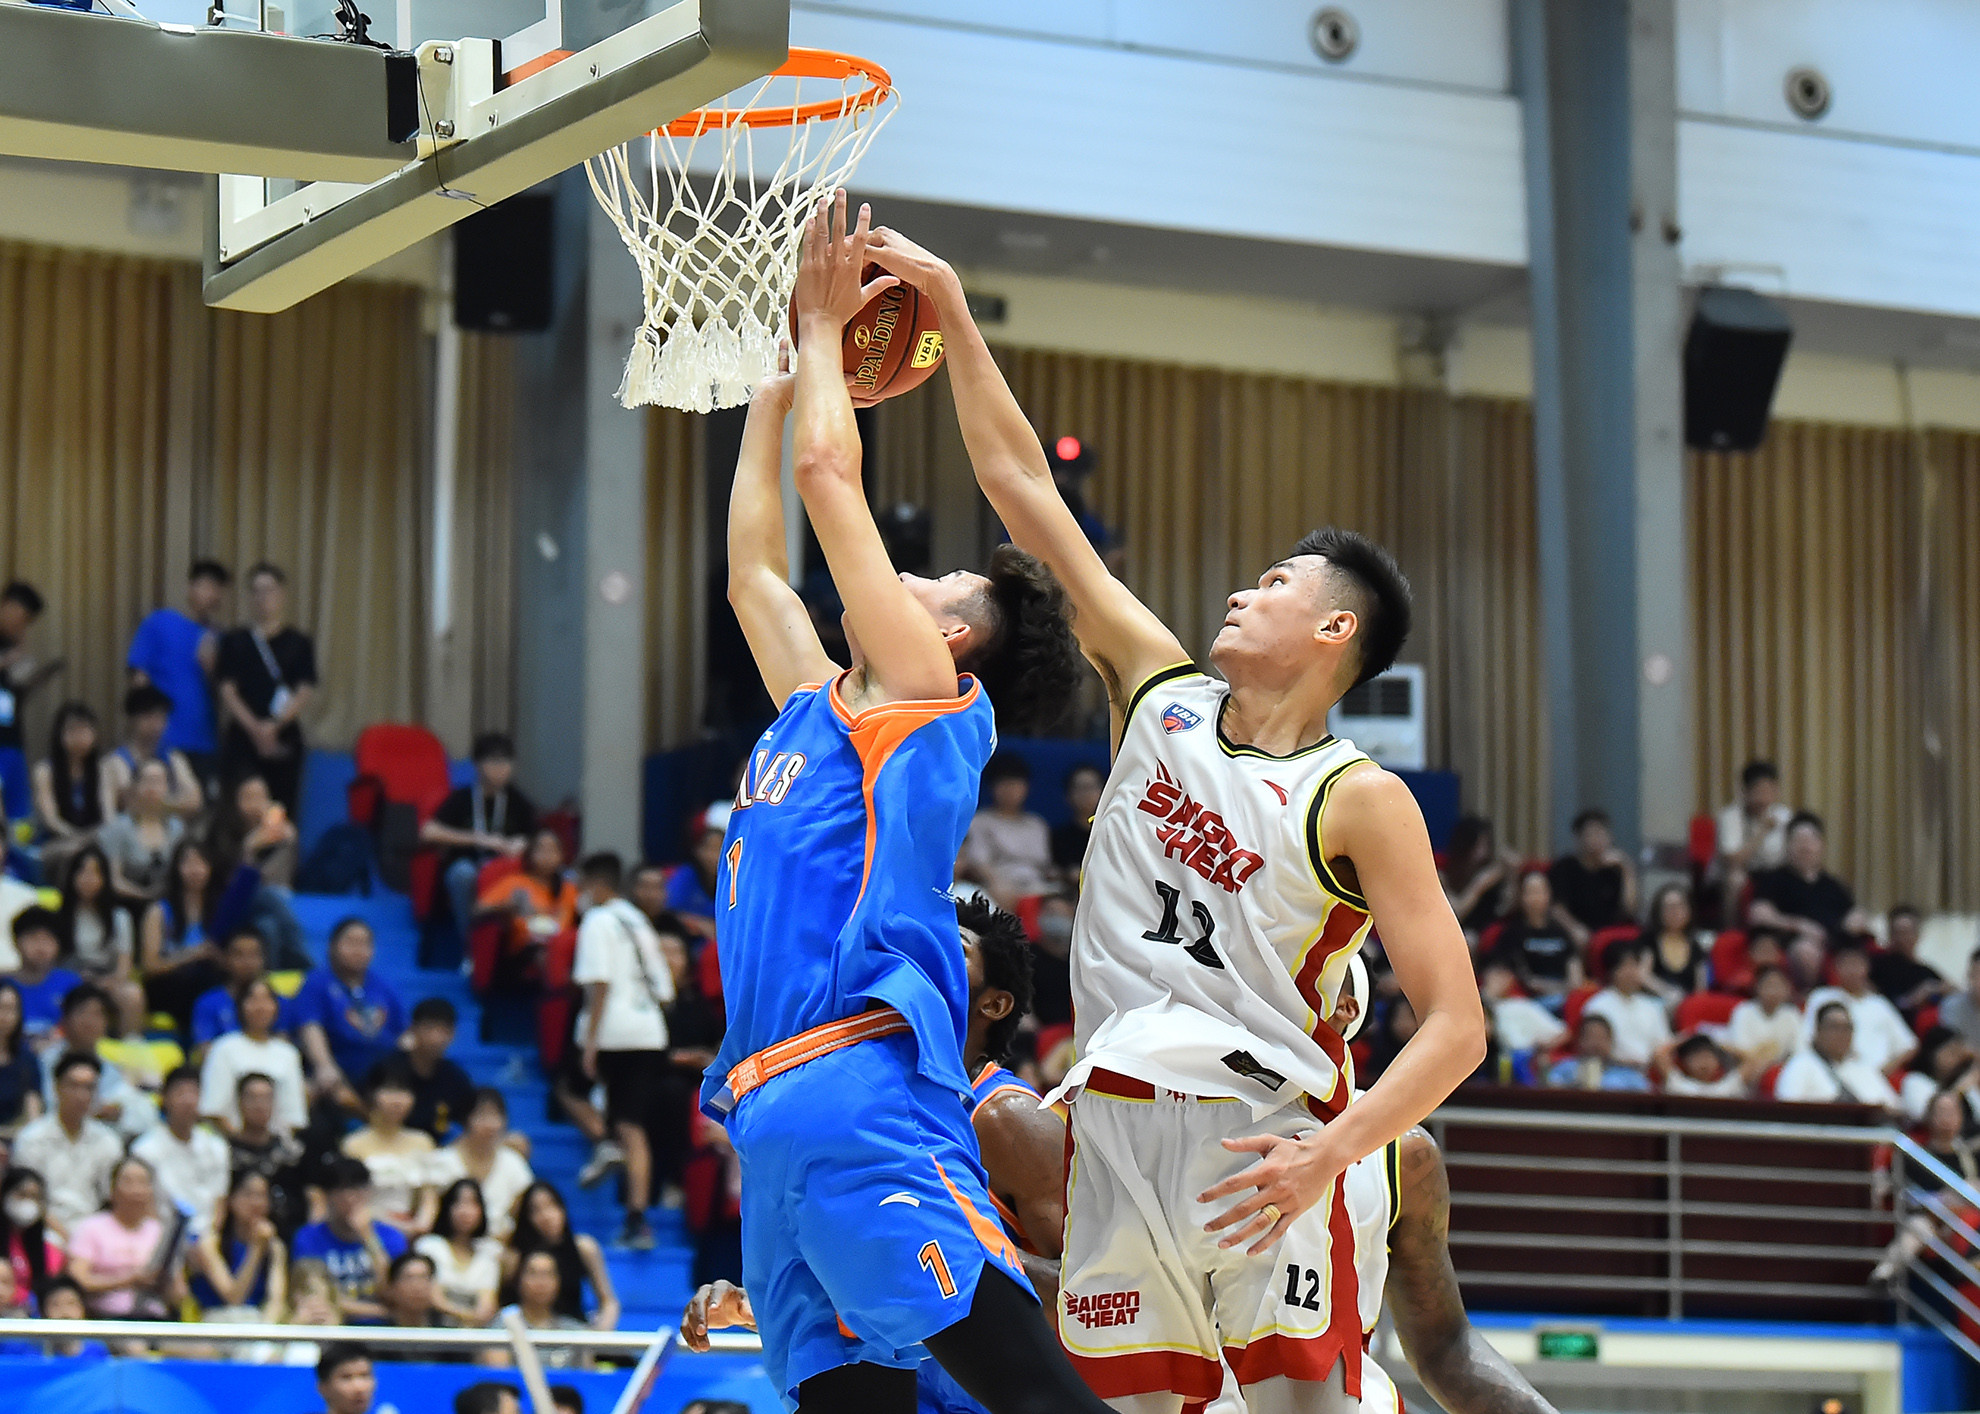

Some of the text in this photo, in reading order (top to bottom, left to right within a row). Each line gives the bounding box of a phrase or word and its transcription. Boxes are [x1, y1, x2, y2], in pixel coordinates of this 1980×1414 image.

[919, 336, 934, 363] VBA
[1171, 705, 1199, 725] VBA
[726, 837, 743, 911] 1
[1157, 823, 1243, 895] HEA
[1141, 879, 1225, 969] 12
[917, 1239, 959, 1300] 1
[1284, 1263, 1321, 1312] 12
[1066, 1290, 1140, 1316] SAIGON
[1079, 1307, 1140, 1330] HEAT
